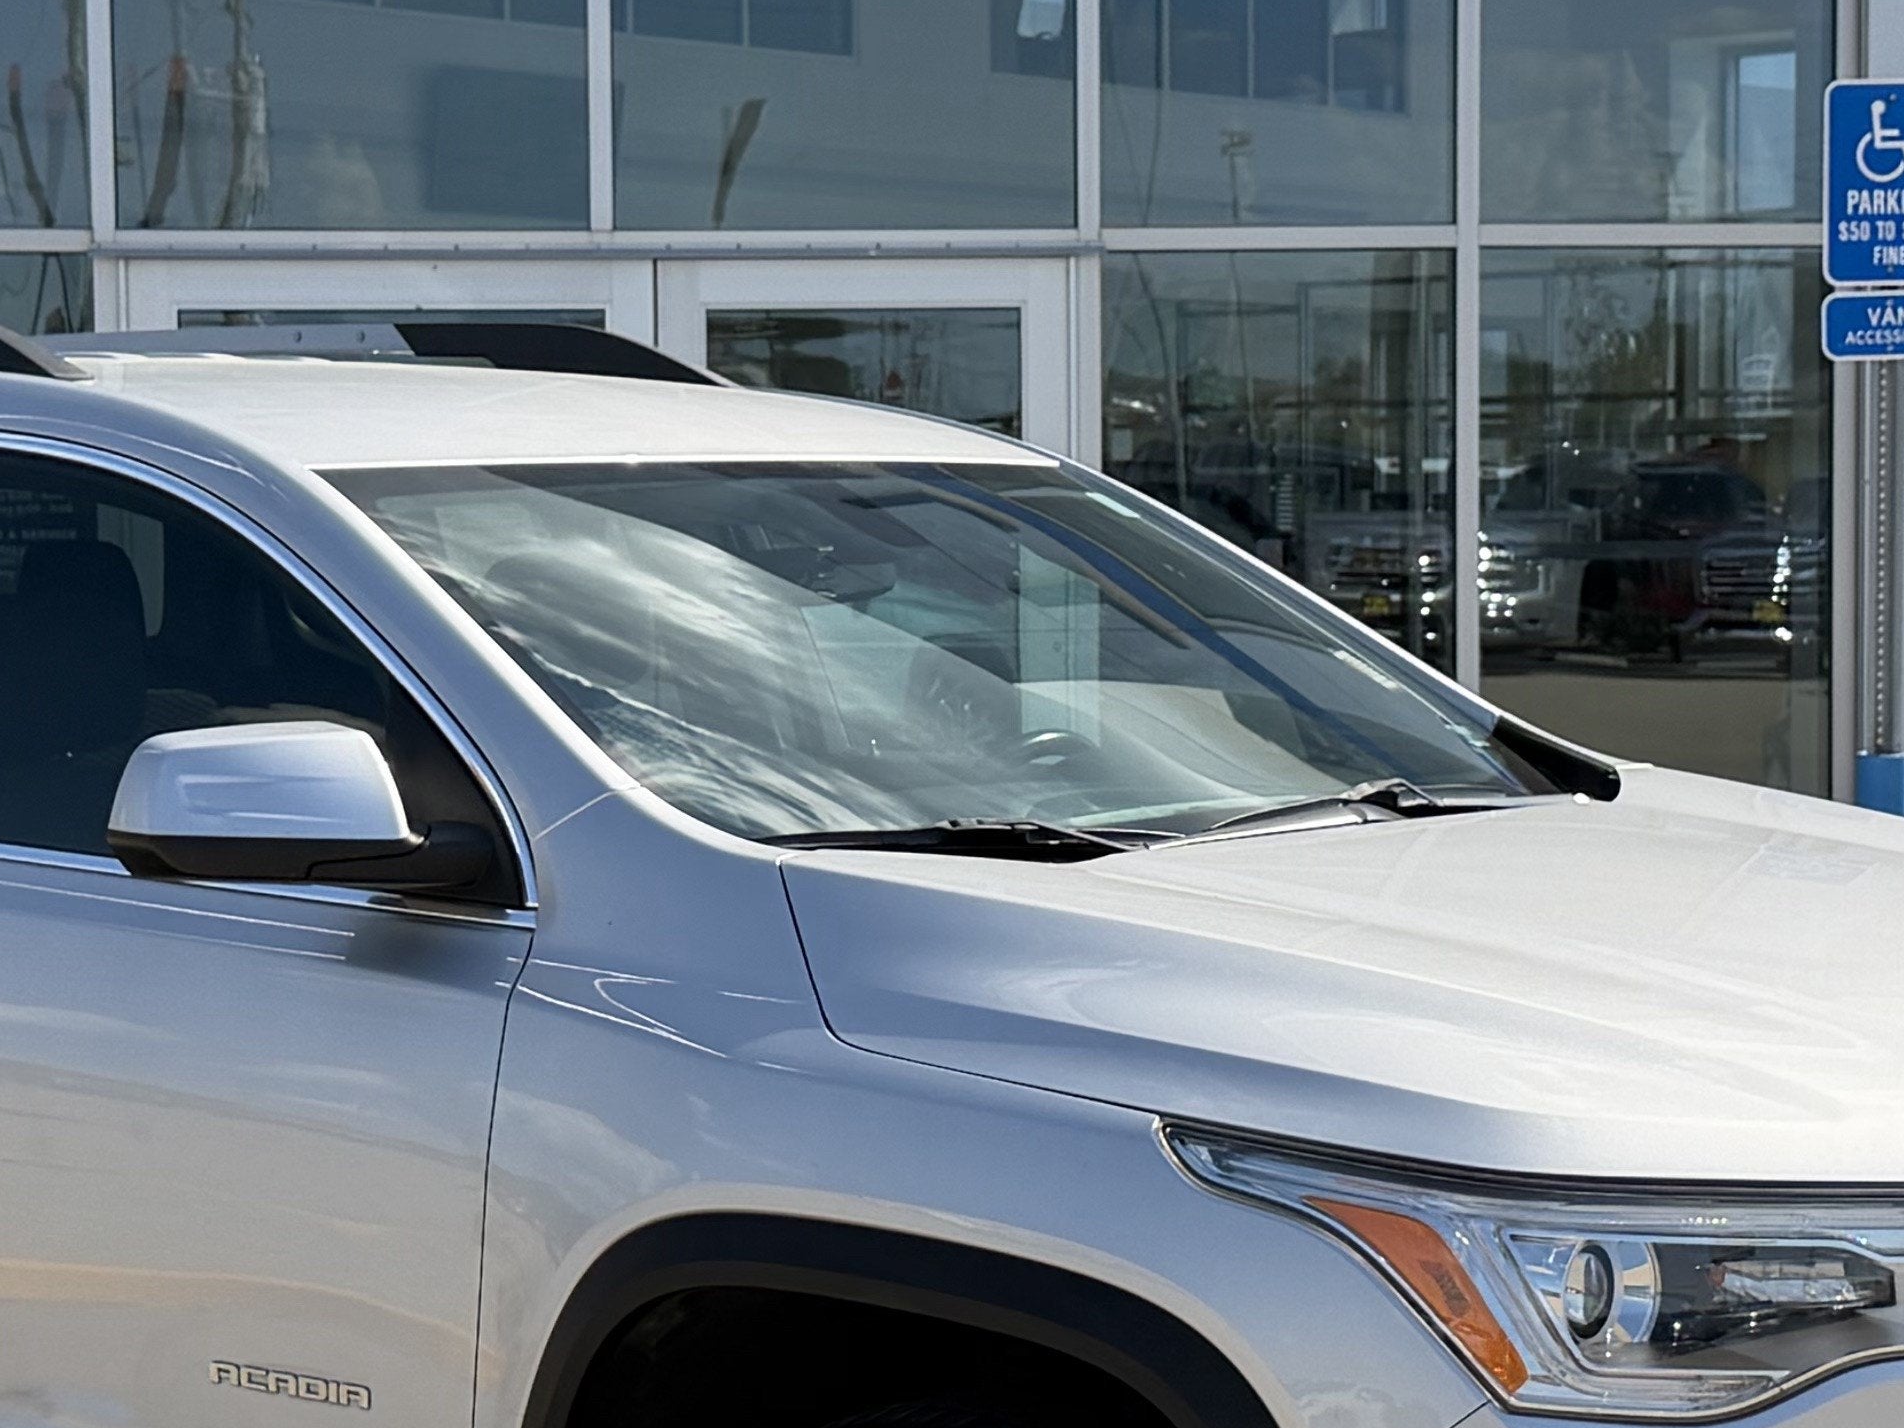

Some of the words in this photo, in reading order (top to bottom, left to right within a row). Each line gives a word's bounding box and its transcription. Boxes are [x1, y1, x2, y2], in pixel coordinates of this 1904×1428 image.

[1838, 220, 1871, 241] $50
[1875, 220, 1896, 241] TO
[208, 1360, 372, 1410] ACADIA
